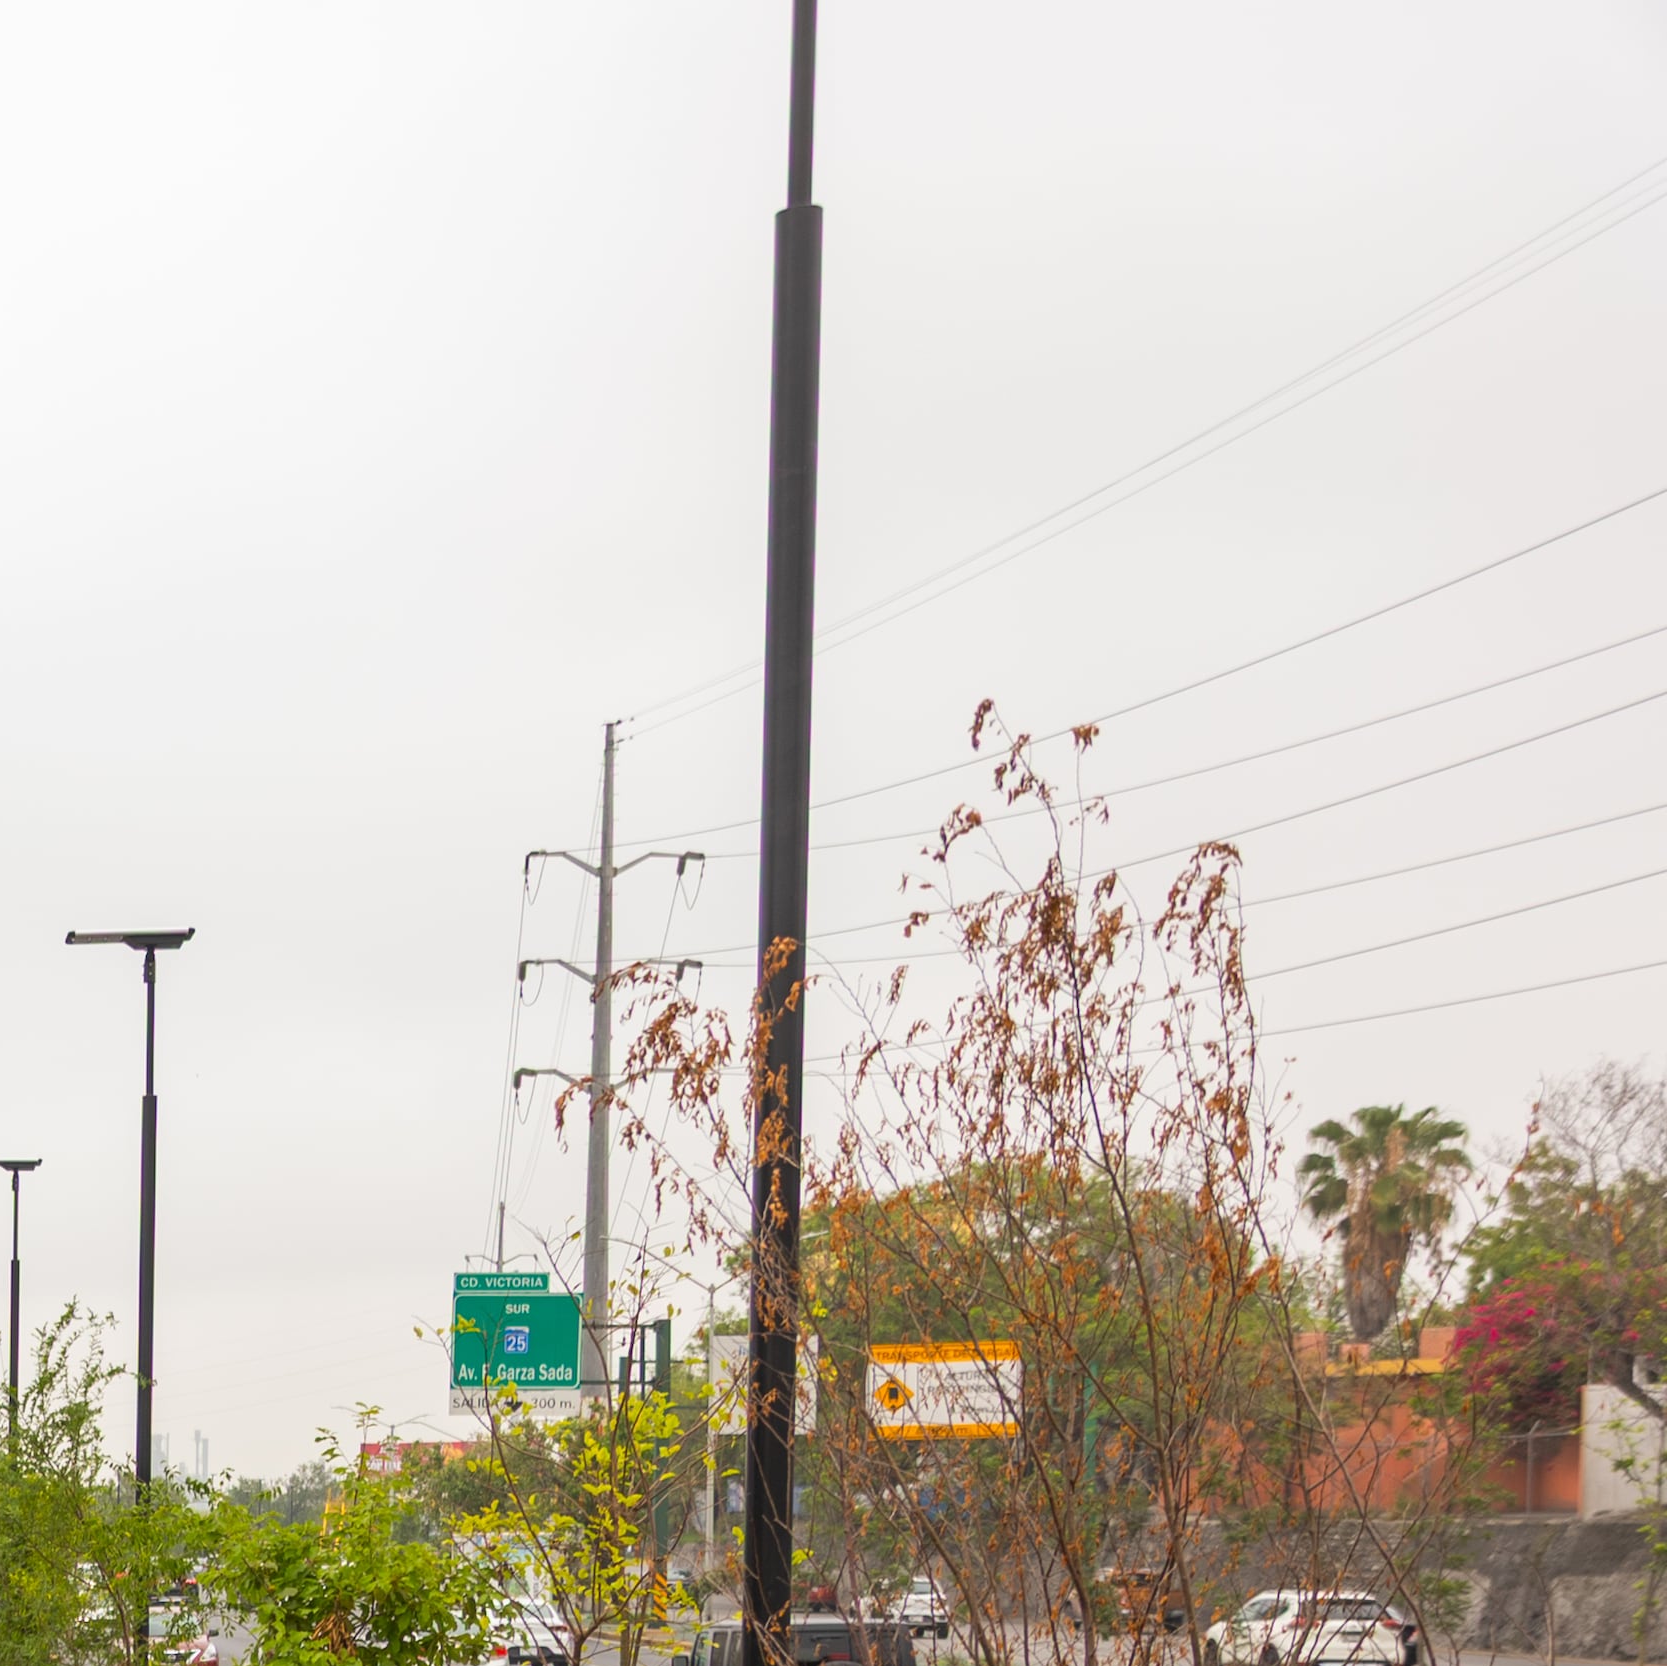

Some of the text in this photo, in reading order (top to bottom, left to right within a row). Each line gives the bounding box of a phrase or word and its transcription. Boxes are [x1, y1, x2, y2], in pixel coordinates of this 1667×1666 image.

[460, 1277, 543, 1288] CD. VICTORIA
[505, 1304, 530, 1314] SUR
[506, 1335, 526, 1352] 25
[458, 1363, 478, 1381] Av.
[497, 1363, 536, 1381] Garza
[538, 1363, 573, 1381] Sada
